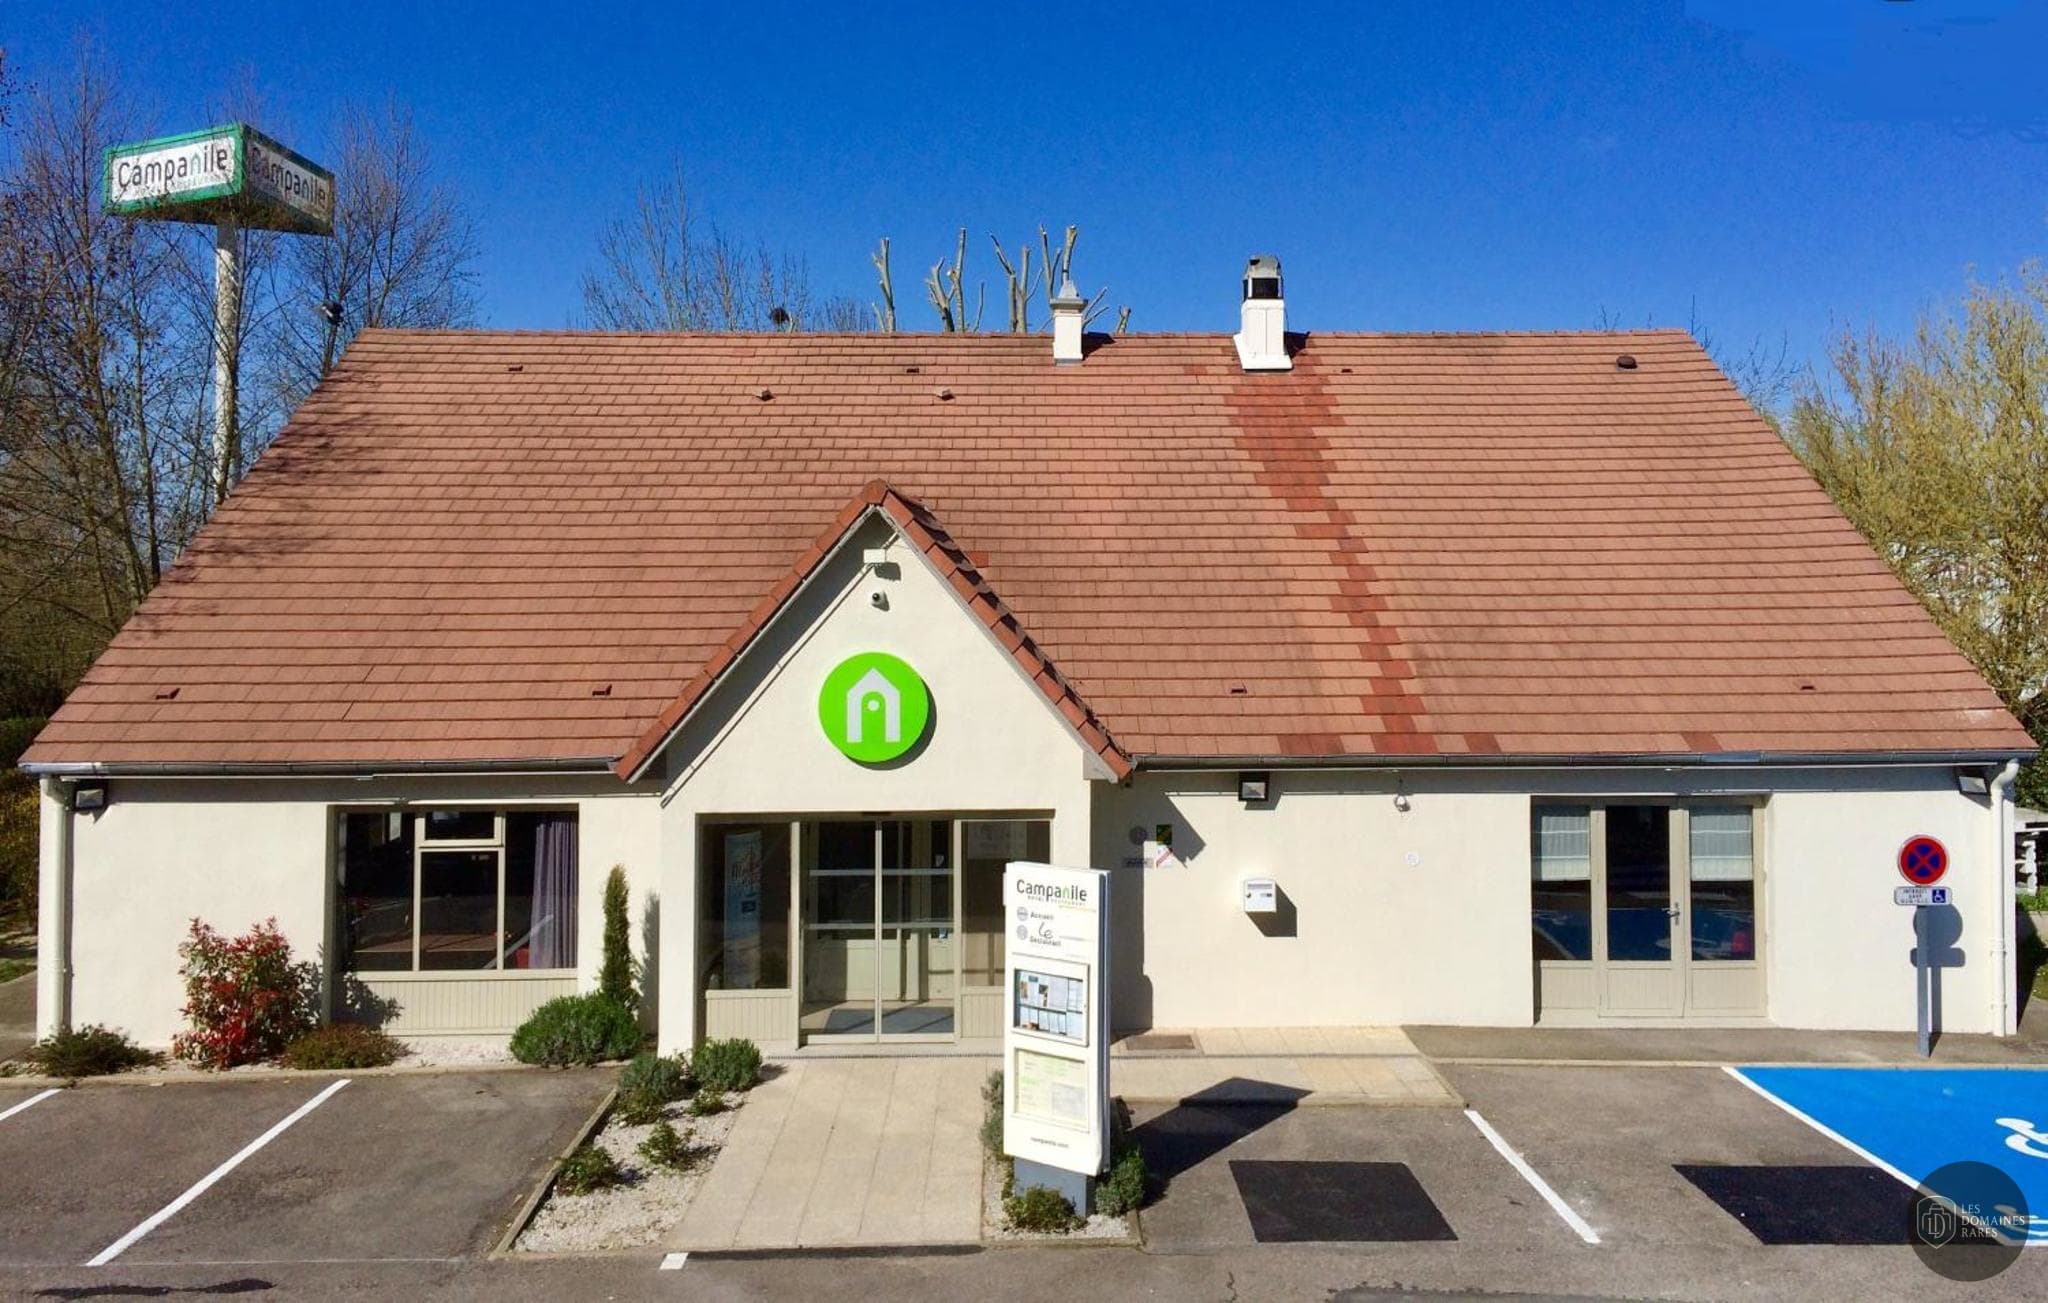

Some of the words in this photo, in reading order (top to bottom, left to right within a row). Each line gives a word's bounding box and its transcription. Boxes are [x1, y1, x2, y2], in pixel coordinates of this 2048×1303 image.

[118, 144, 228, 190] Campanile
[251, 147, 326, 206] Campanile
[1016, 879, 1087, 902] Campanile
